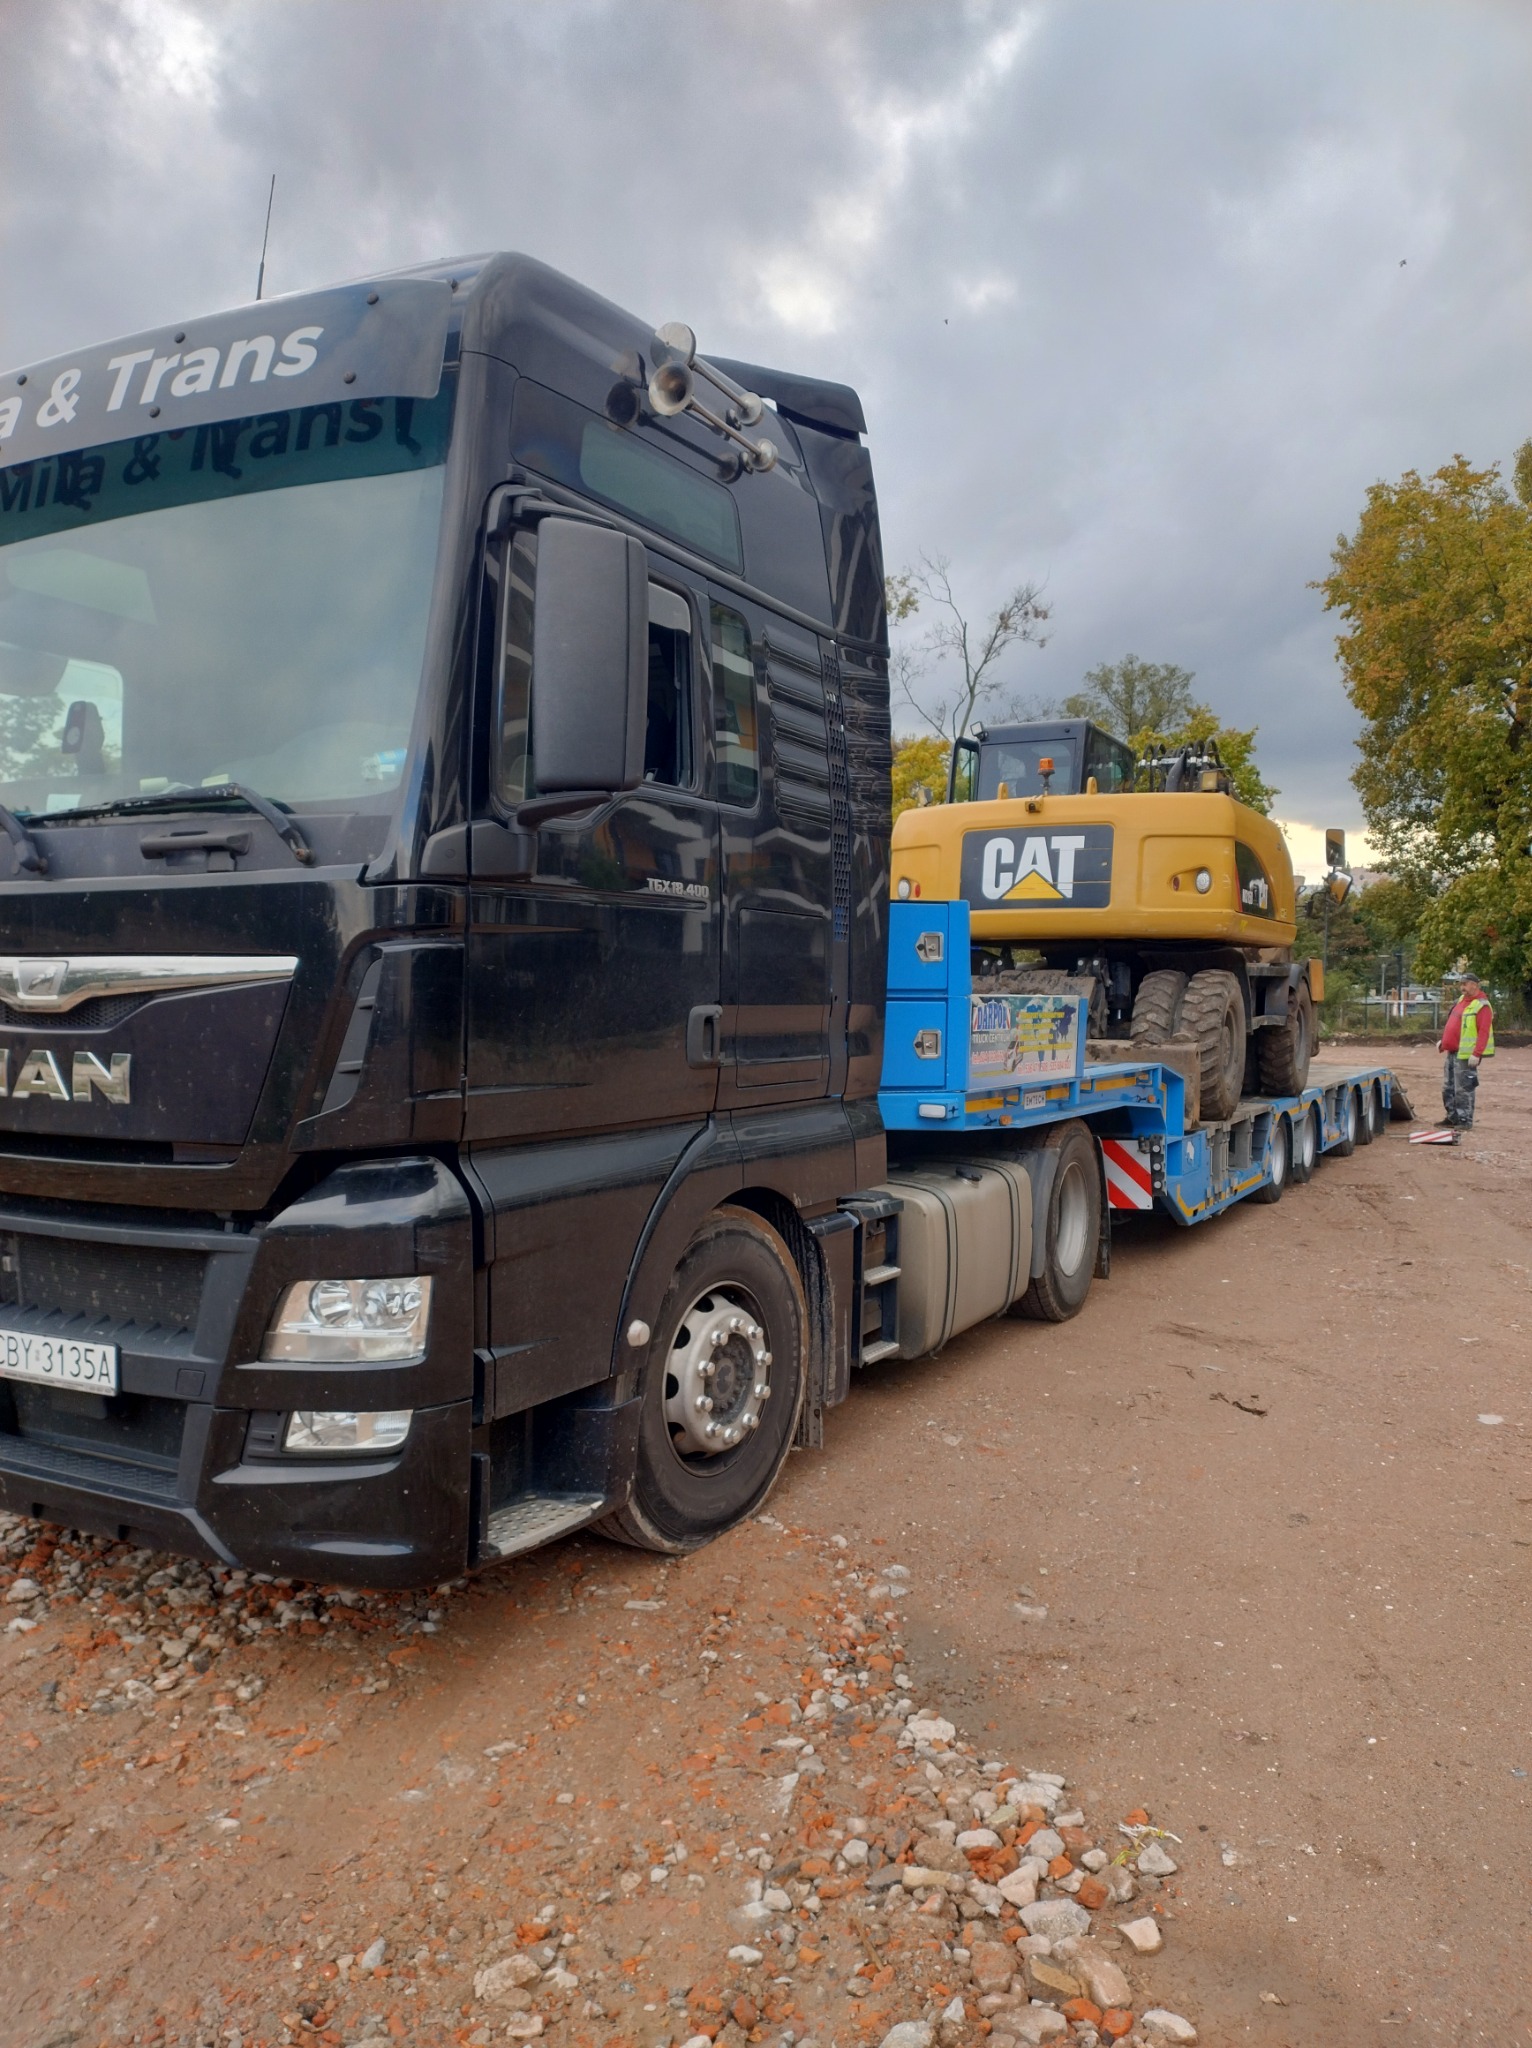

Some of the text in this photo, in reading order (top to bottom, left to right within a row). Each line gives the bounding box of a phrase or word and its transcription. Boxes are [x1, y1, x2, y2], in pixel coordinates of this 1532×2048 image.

[36, 367, 82, 429] &
[106, 326, 324, 412] Trans
[981, 835, 1086, 901] CAT
[42, 1341, 111, 1384] 3135A
